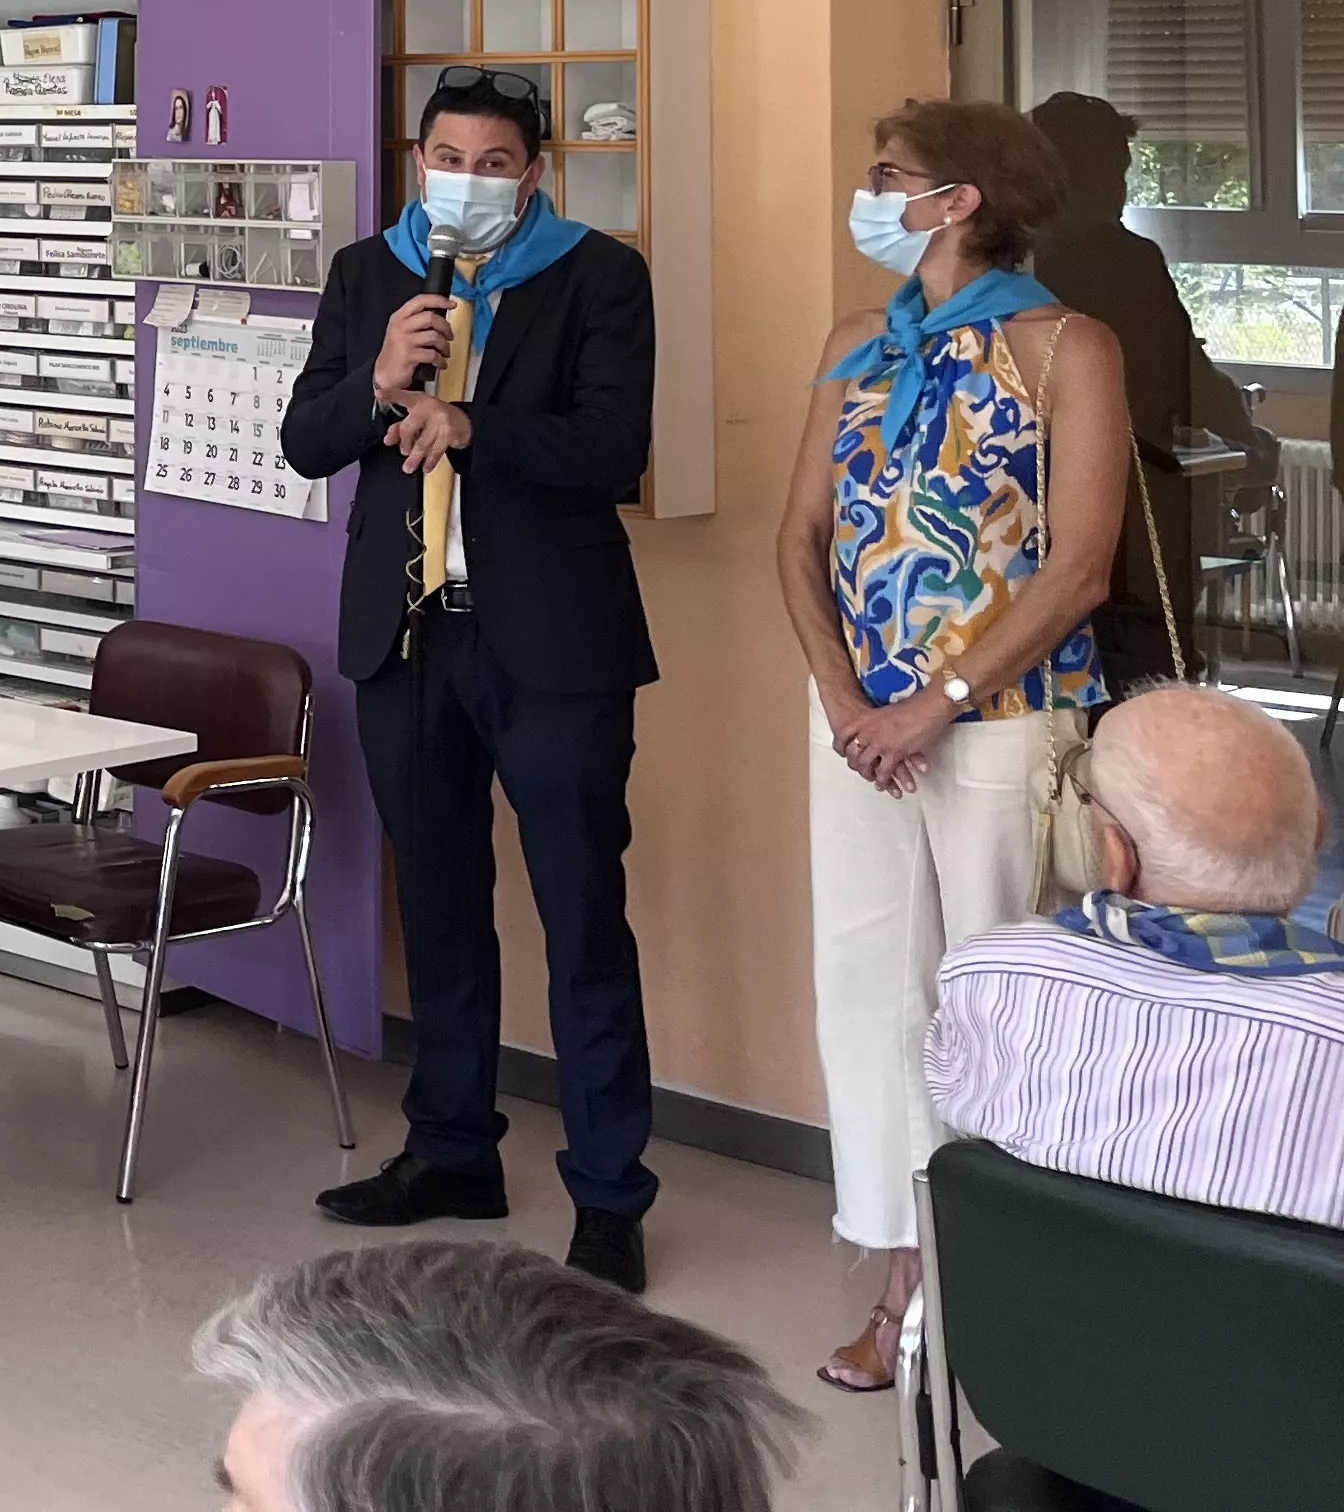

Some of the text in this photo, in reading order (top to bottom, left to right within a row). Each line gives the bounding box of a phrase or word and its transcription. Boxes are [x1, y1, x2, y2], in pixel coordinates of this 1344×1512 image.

[171, 335, 238, 353] septiembre
[253, 367, 283, 384] 1 2
[164, 383, 283, 412] 4 5 6 7 8 9
[163, 410, 169, 423] 11
[185, 413, 194, 427] 12
[207, 416, 216, 430] 13
[230, 419, 239, 434] 14
[253, 423, 263, 438] 15
[160, 437, 286, 470] 18 19 20 21 22 23
[156, 464, 286, 499] 25 26 27 28 29 30
